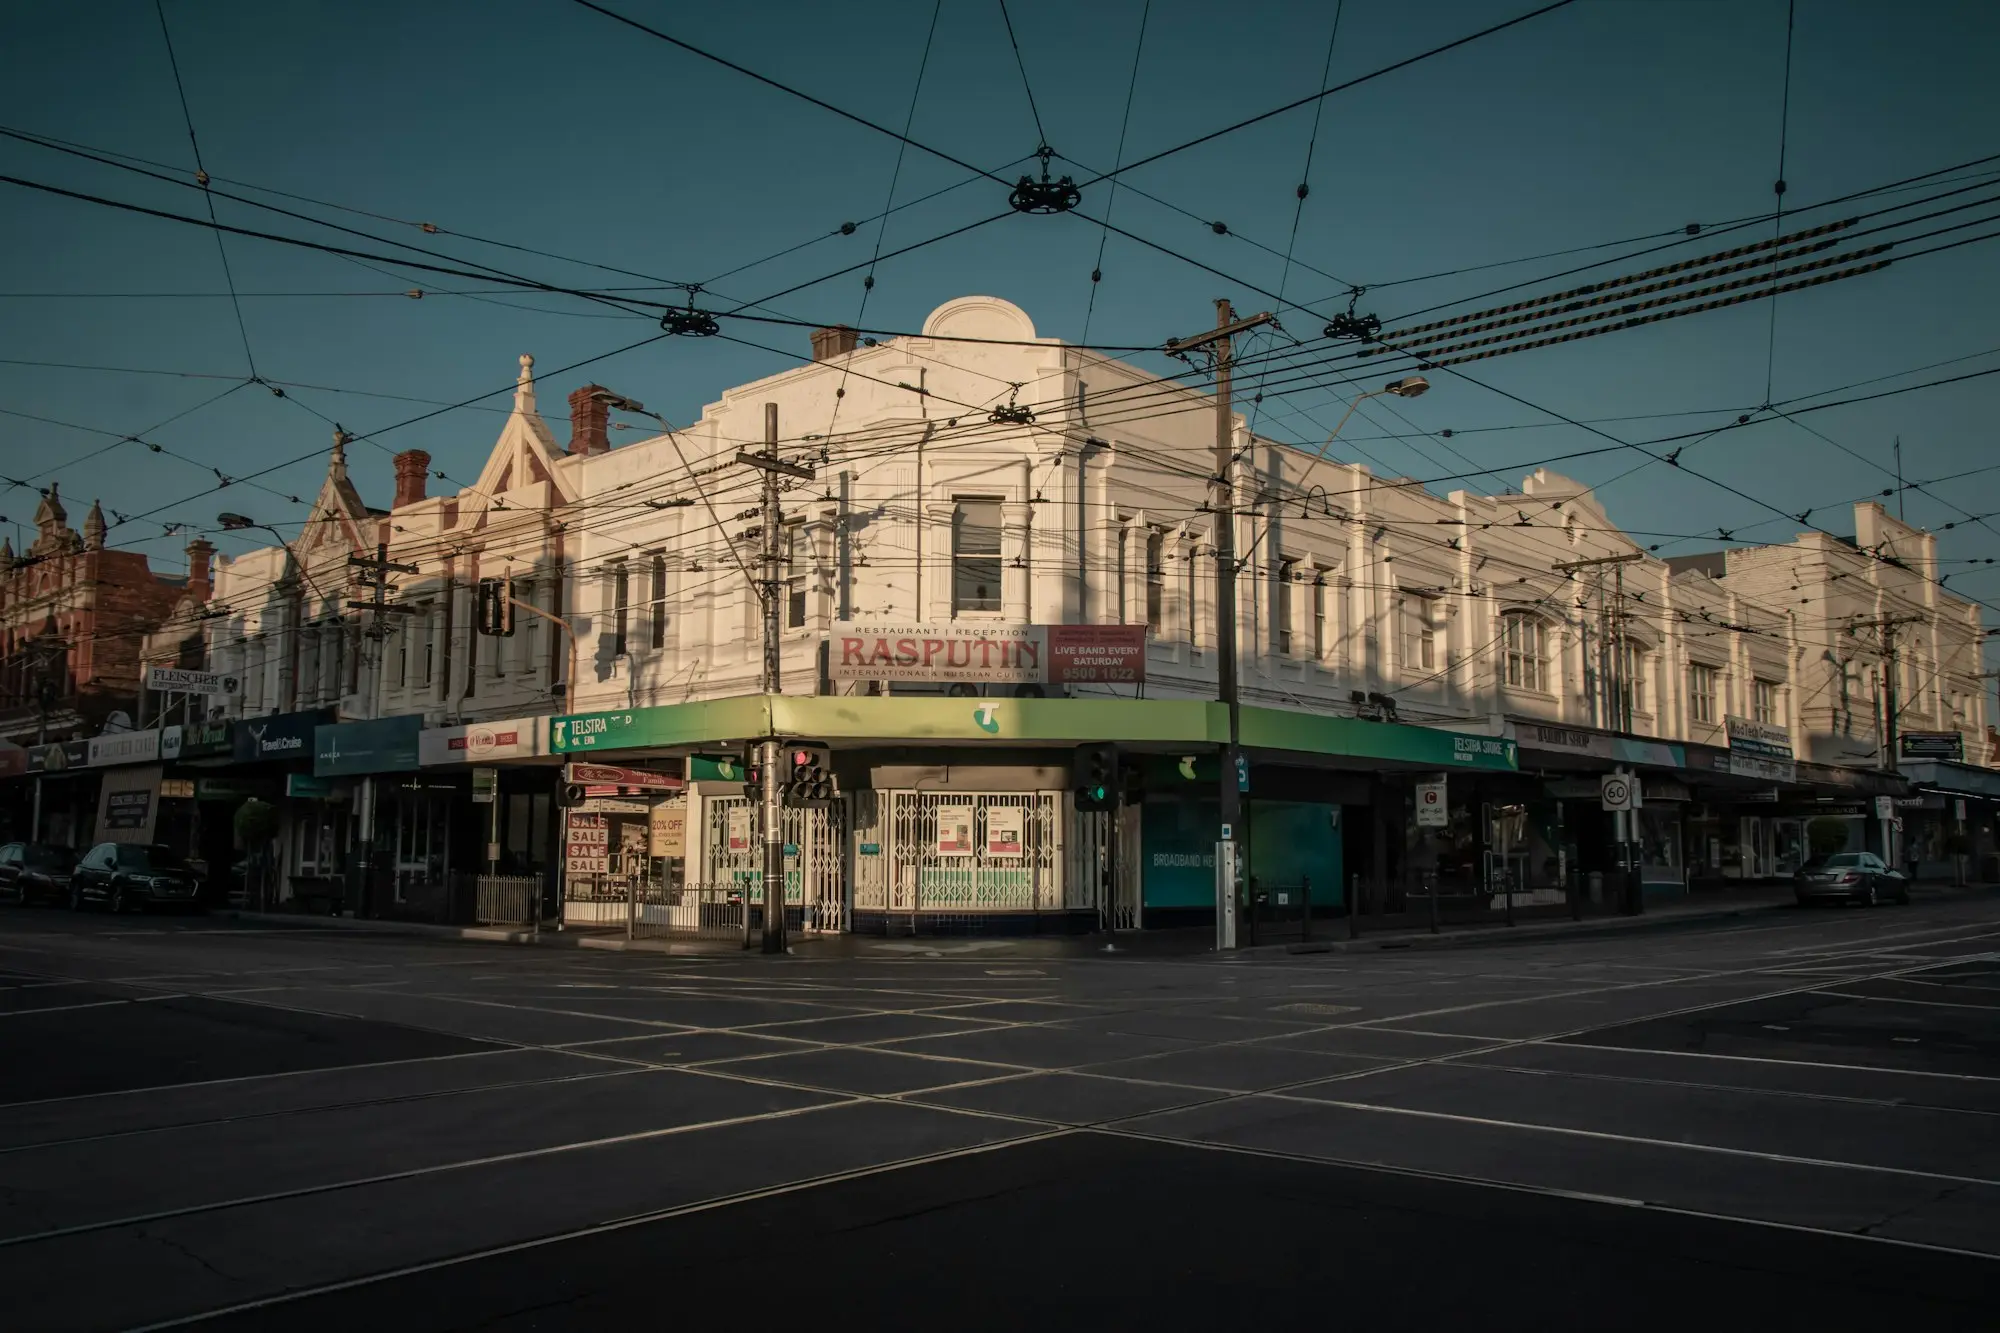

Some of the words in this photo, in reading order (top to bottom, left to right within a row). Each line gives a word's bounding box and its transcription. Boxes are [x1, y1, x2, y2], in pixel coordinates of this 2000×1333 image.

[855, 626, 939, 636] RESTAURANT
[955, 628, 1029, 637] RECEPTION
[841, 637, 1040, 669] RASPUTIN
[1054, 646, 1076, 655] LIVE
[1078, 646, 1105, 655] BAND
[1107, 646, 1140, 655] EVERY
[1072, 656, 1124, 666] SATURDAY
[153, 668, 218, 686] FLEISCHER
[839, 670, 927, 678] INTERNATIONAL
[943, 671, 990, 679] RUSSIAN
[1062, 668, 1096, 679] 9500
[571, 718, 607, 735] TELSTRA
[1453, 737, 1482, 753] TELSTRA
[1482, 740, 1504, 756] STORE
[643, 776, 665, 786] Family
[1608, 786, 1625, 798] 60
[652, 820, 667, 831] 20%
[667, 819, 683, 830] OFF
[571, 831, 606, 842] SALE
[571, 845, 605, 857] SALE
[570, 860, 605, 871] SALE
[1153, 853, 1201, 868] BROADBAND
